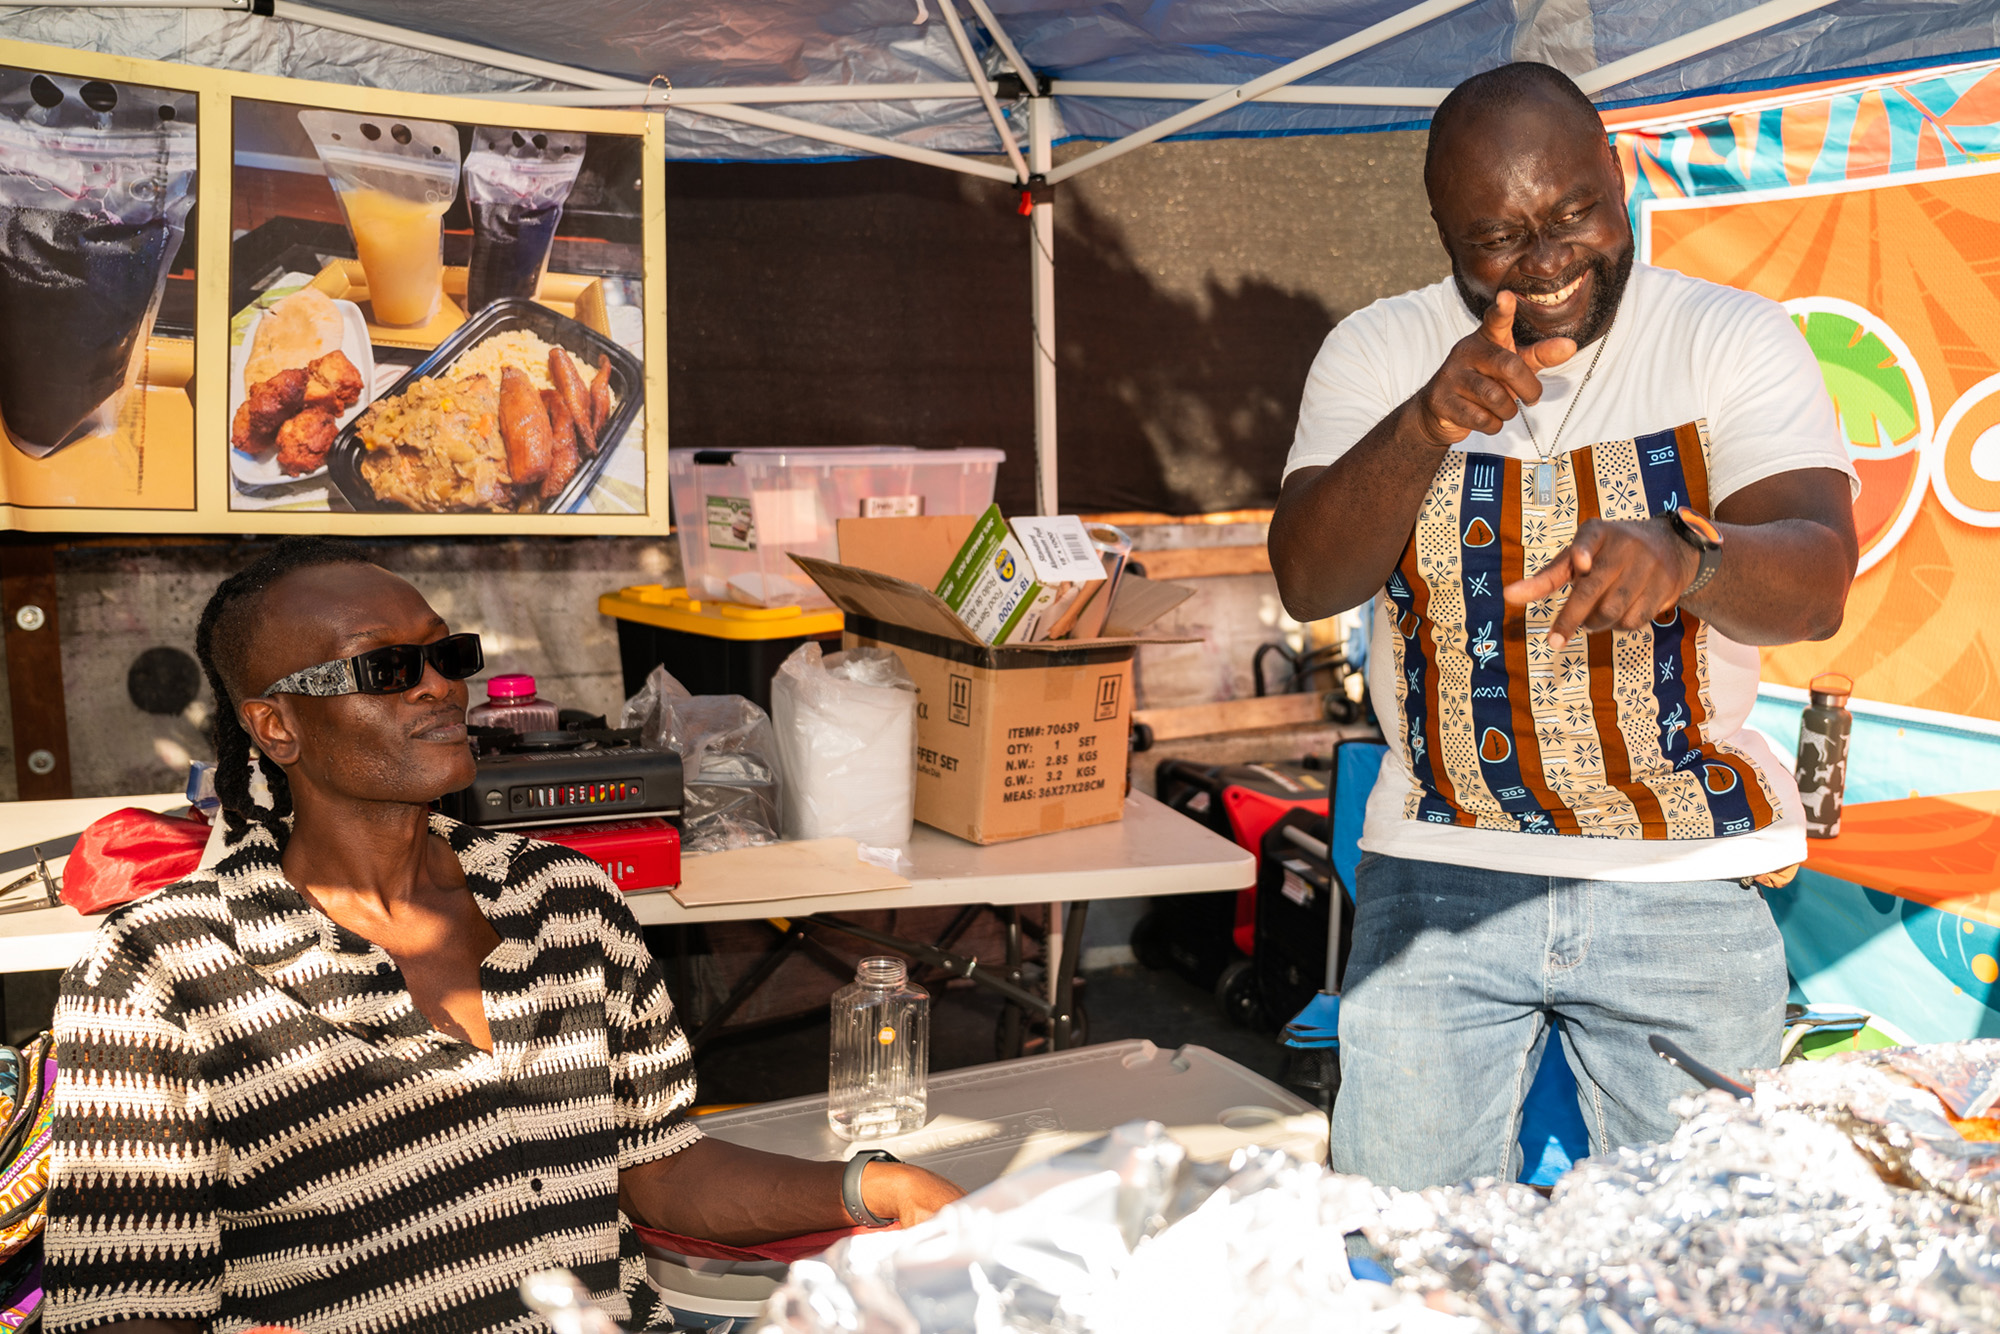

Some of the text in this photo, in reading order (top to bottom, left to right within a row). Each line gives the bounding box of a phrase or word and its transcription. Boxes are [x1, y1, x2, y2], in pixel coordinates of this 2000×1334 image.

[966, 533, 985, 563] SMALLER
[1029, 534, 1047, 562] Standard
[1032, 526, 1058, 569] Aluminum Foil
[956, 560, 967, 579] BOX
[982, 576, 997, 596] Rollo
[974, 595, 983, 607] de
[987, 588, 1004, 611] Food
[1008, 722, 1080, 739] ITEM#: 70639
[1007, 735, 1096, 755] QTY: 1 SET
[940, 754, 959, 772] SET
[1005, 751, 1098, 771] N.W.: 2.85 KGS
[1004, 765, 1096, 787] G.W.: 3.2 KGS
[1003, 778, 1105, 803] MEAS: 36X27X28CM
